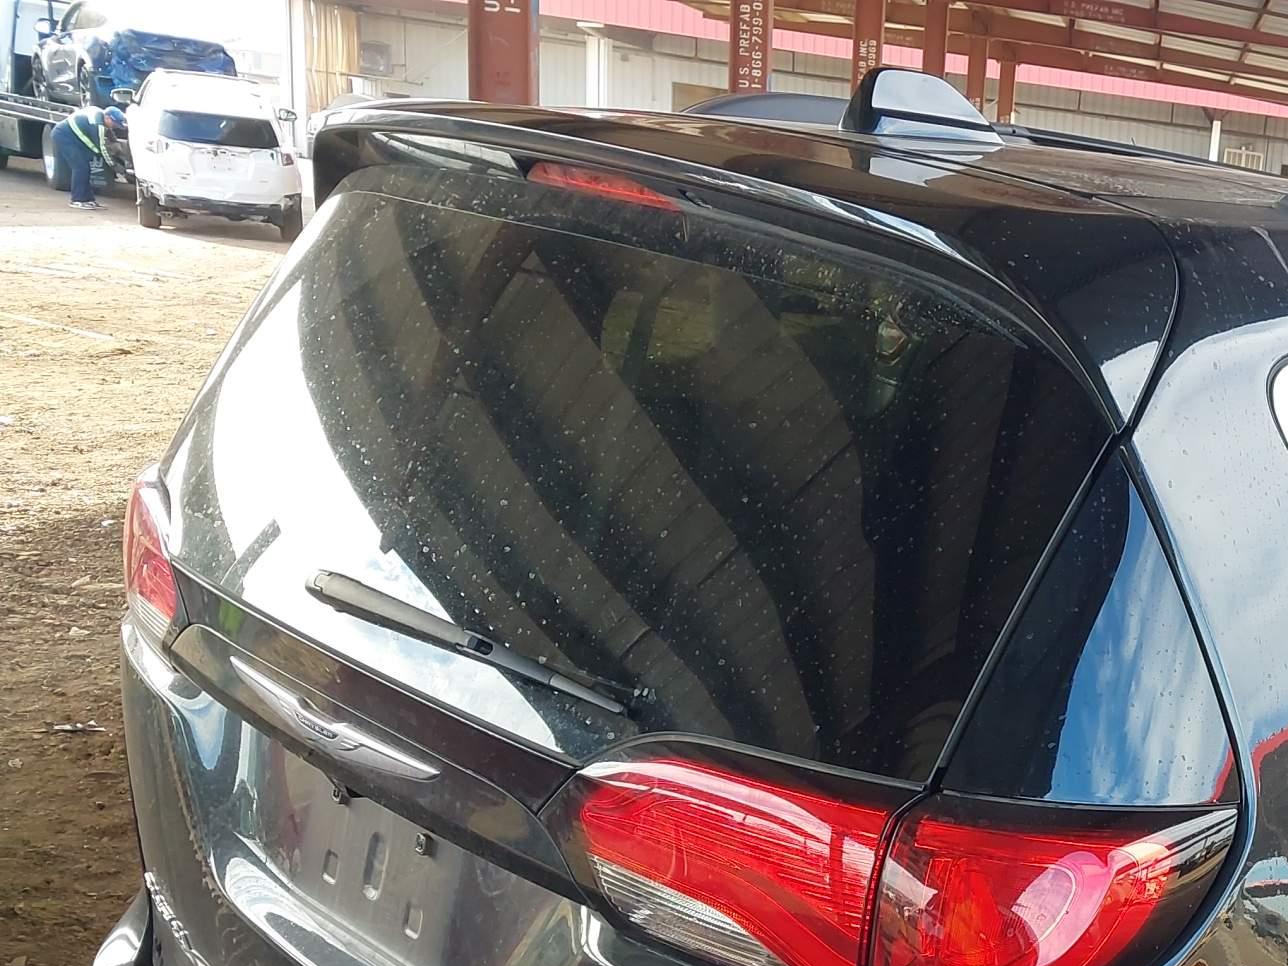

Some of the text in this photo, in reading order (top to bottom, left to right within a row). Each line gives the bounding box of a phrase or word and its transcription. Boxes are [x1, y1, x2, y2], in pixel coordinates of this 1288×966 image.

[738, 4, 751, 88] U.S. PREFAB
[751, 0, 764, 89] 1-866-799-0
